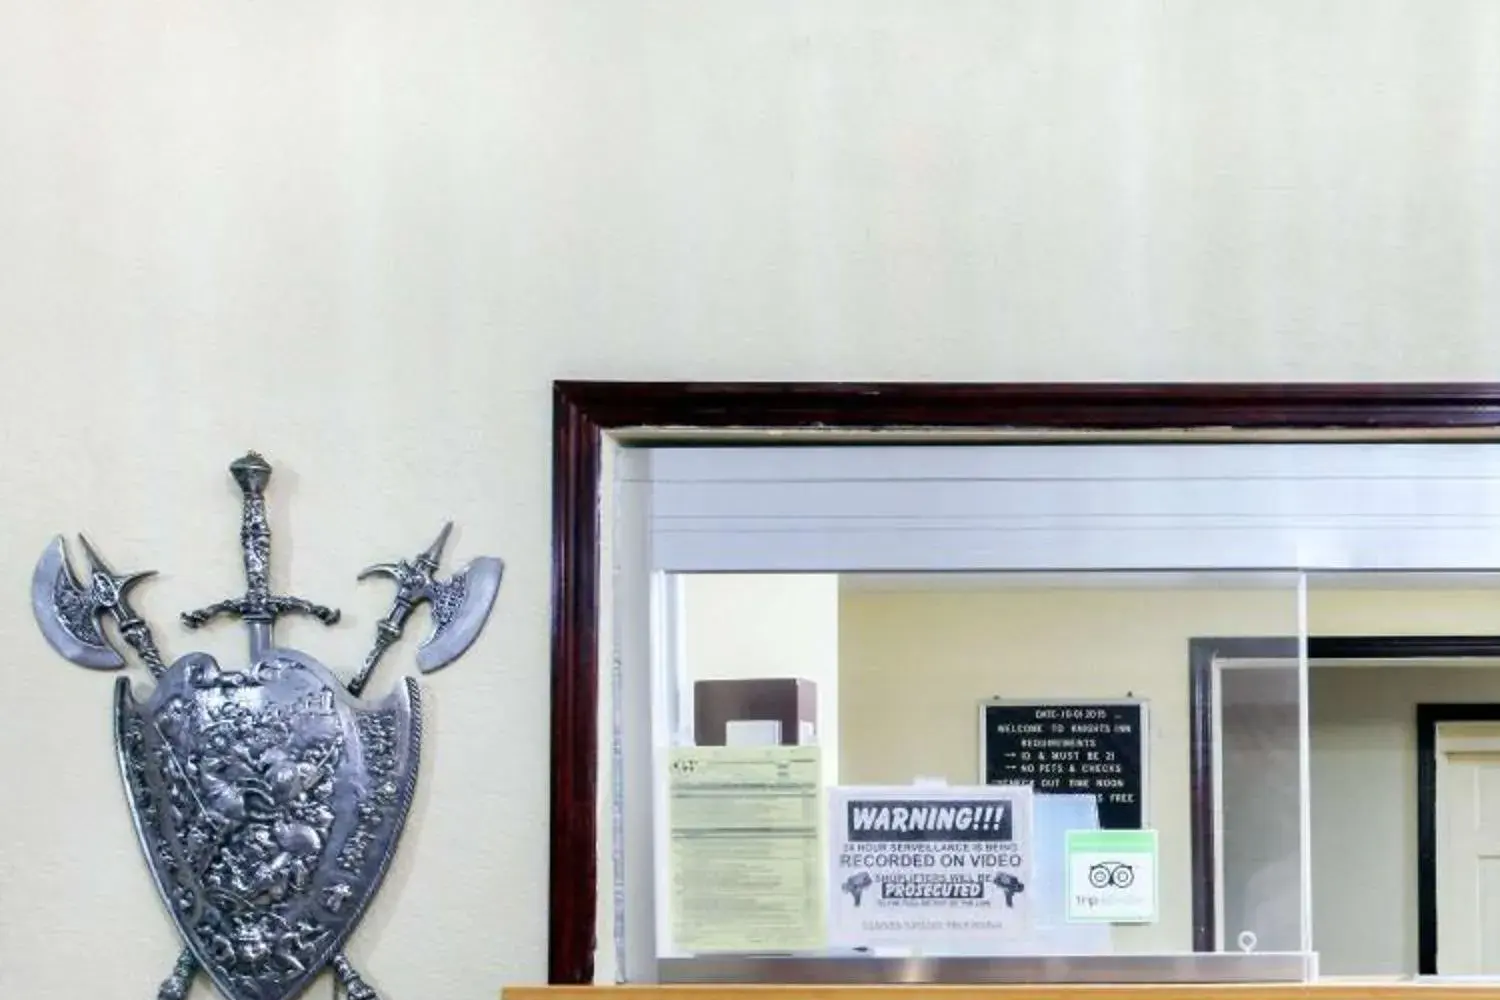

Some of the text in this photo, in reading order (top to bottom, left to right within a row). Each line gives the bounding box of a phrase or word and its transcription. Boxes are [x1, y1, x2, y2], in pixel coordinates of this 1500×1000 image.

[997, 723, 1132, 733] WELCOME TO KNIGHTS INN
[1020, 738, 1097, 748] REQUIREMENTS
[1021, 751, 1116, 761] ID & MUST BE 21
[1021, 764, 1122, 774] NO PETS & CHECKS
[1041, 778, 1061, 788] OUT
[1069, 778, 1090, 788] TIME
[1096, 778, 1125, 788] NOON
[1109, 794, 1135, 804] FREE
[852, 805, 1005, 832] WARNING!!!
[856, 843, 887, 853] HOUR
[984, 843, 1018, 853] BEING
[840, 853, 1022, 868] RECORDED ON VIDEO
[977, 873, 993, 883] BE
[885, 882, 980, 897] PROSECUTED
